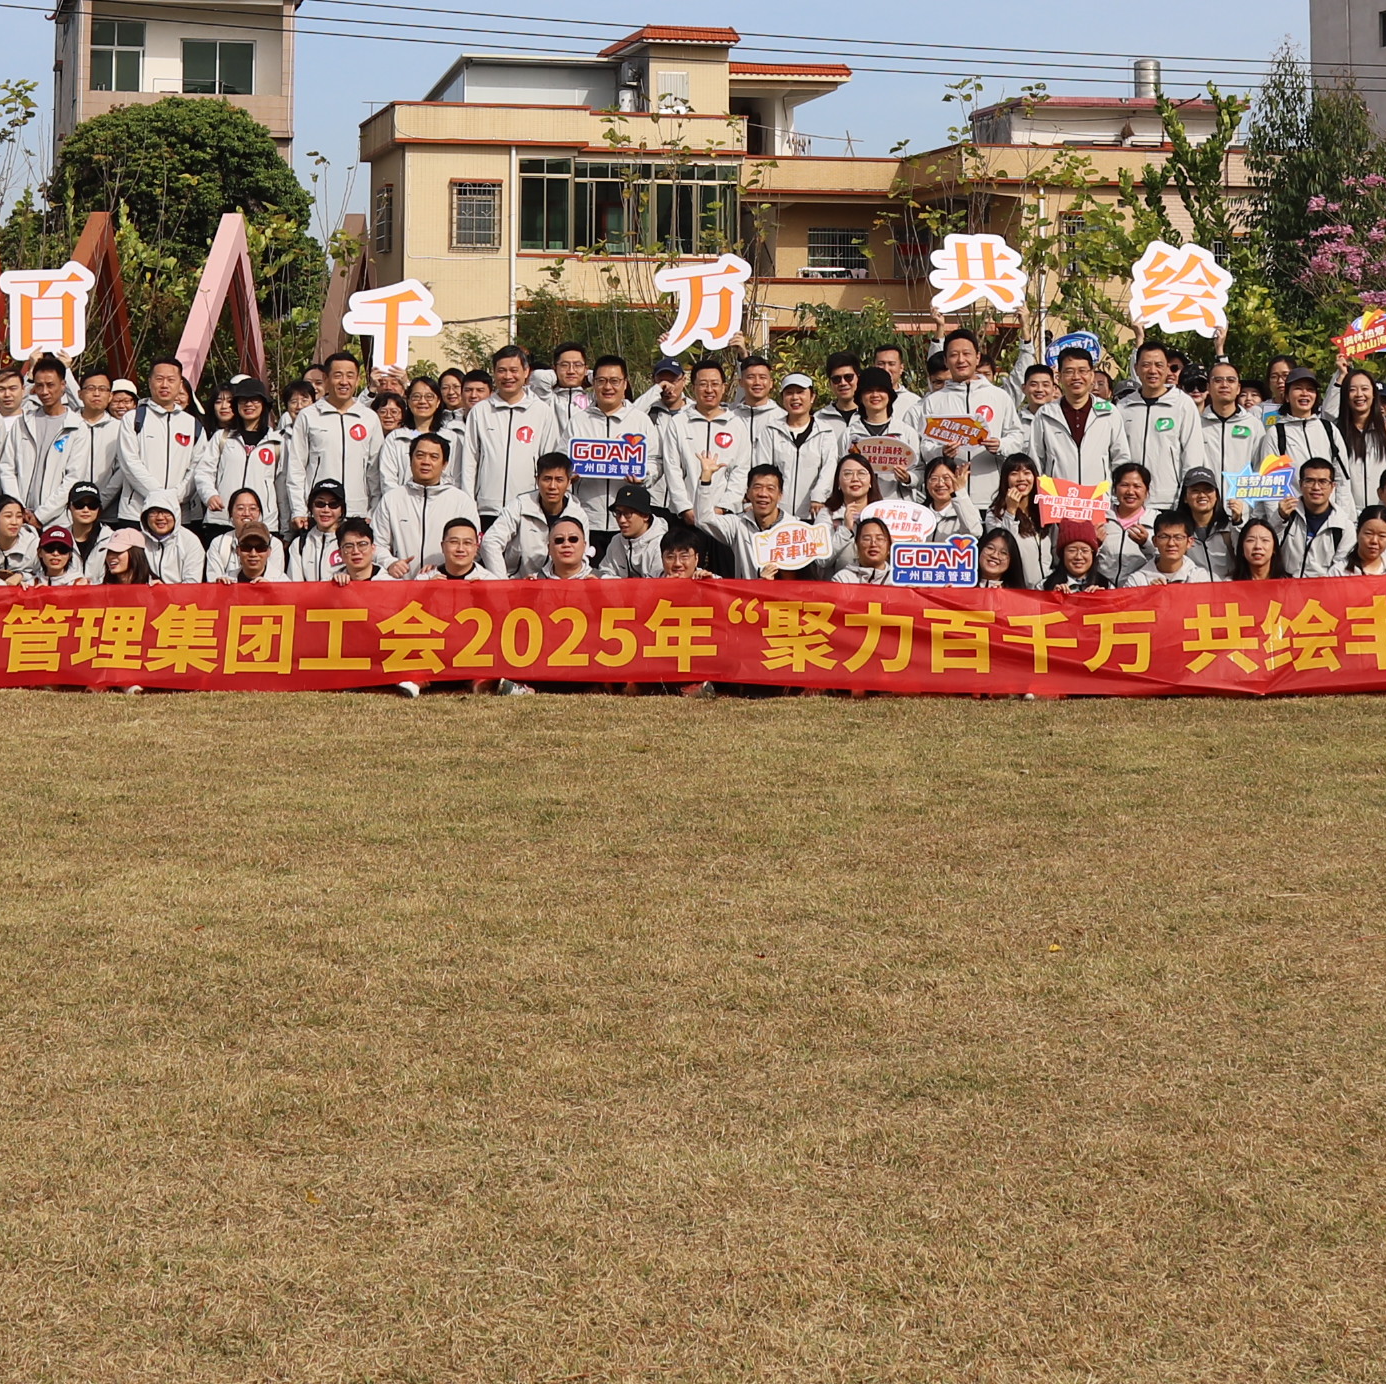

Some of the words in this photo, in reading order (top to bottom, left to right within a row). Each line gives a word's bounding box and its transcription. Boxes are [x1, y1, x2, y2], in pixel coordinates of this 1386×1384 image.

[941, 242, 1016, 303] 共
[1141, 251, 1222, 328] 绘
[10, 272, 84, 350] 百
[665, 264, 741, 345] 万
[353, 289, 431, 365] 千
[572, 442, 644, 463] GOAM
[862, 445, 903, 455] 红叶满枝
[573, 463, 642, 476] 广州国资管理
[775, 528, 808, 547] 金秋
[769, 542, 821, 563] 庆丰收
[895, 546, 973, 568] GOAM
[896, 569, 972, 583] 广州国资管理
